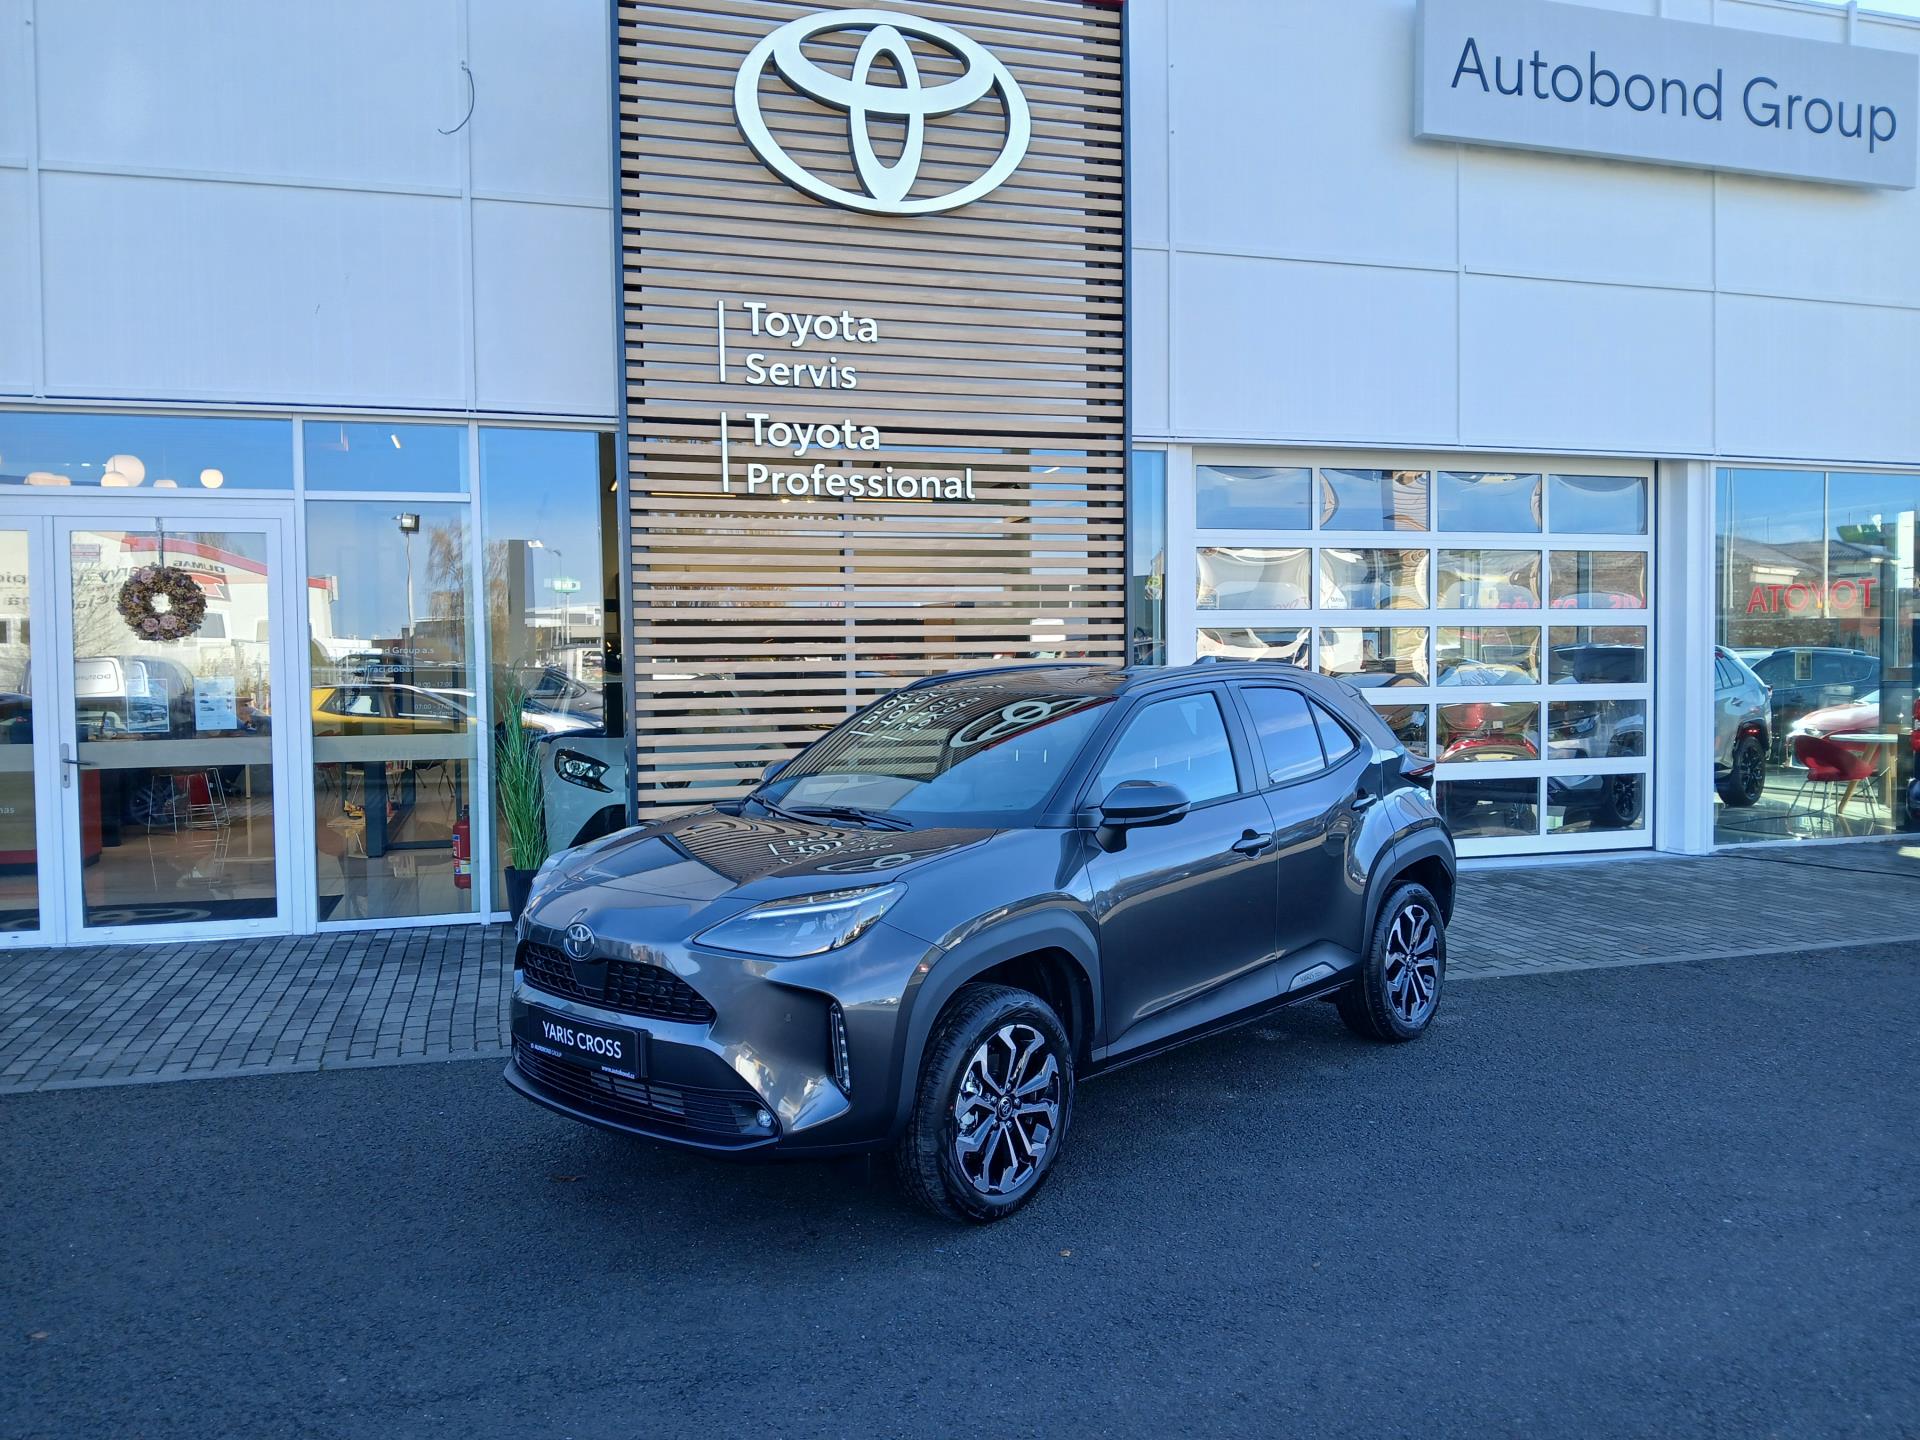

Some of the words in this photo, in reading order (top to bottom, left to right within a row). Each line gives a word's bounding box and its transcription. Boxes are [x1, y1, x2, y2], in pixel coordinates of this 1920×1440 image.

[1451, 36, 1723, 123] Autobond
[1742, 75, 1898, 154] Group
[743, 300, 879, 348] Toyota
[745, 353, 857, 390] Servis
[745, 412, 881, 458] Toyota
[746, 462, 976, 501] Professional
[542, 1020, 575, 1047] YARIS
[576, 1032, 623, 1059] CROSS
